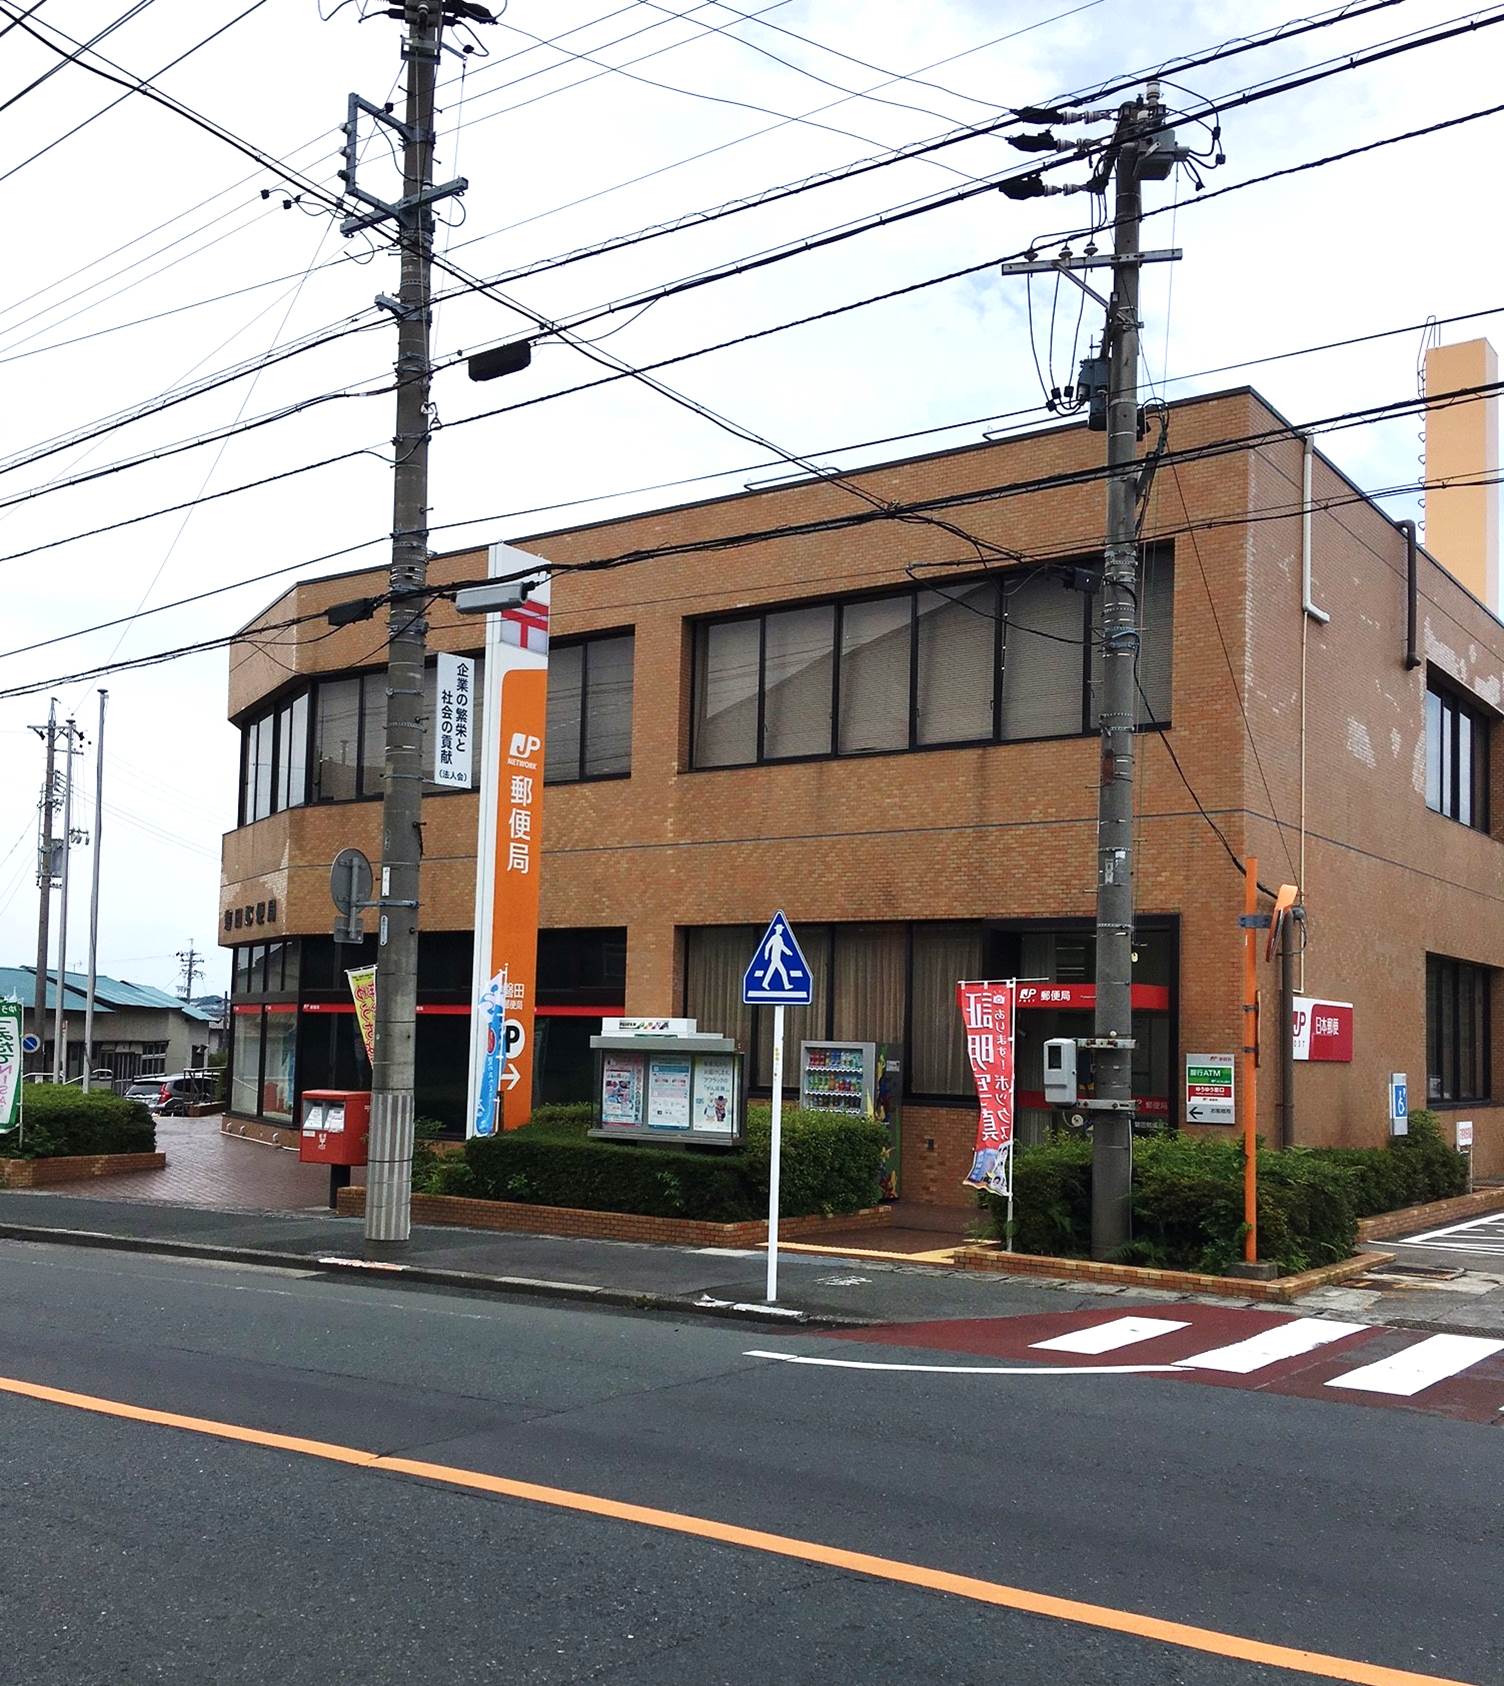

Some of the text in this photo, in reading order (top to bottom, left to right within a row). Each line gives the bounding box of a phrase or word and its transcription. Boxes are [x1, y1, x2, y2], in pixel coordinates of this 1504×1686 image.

[456, 662, 469, 753] 企業の繁栄と
[440, 689, 453, 765] 社会の貢献
[507, 758, 537, 770] NETWORK
[507, 775, 533, 875] 郵便局
[1040, 991, 1071, 1001] 郵便局
[1315, 1016, 1339, 1035] 日本郵便
[506, 1026, 520, 1053] P
